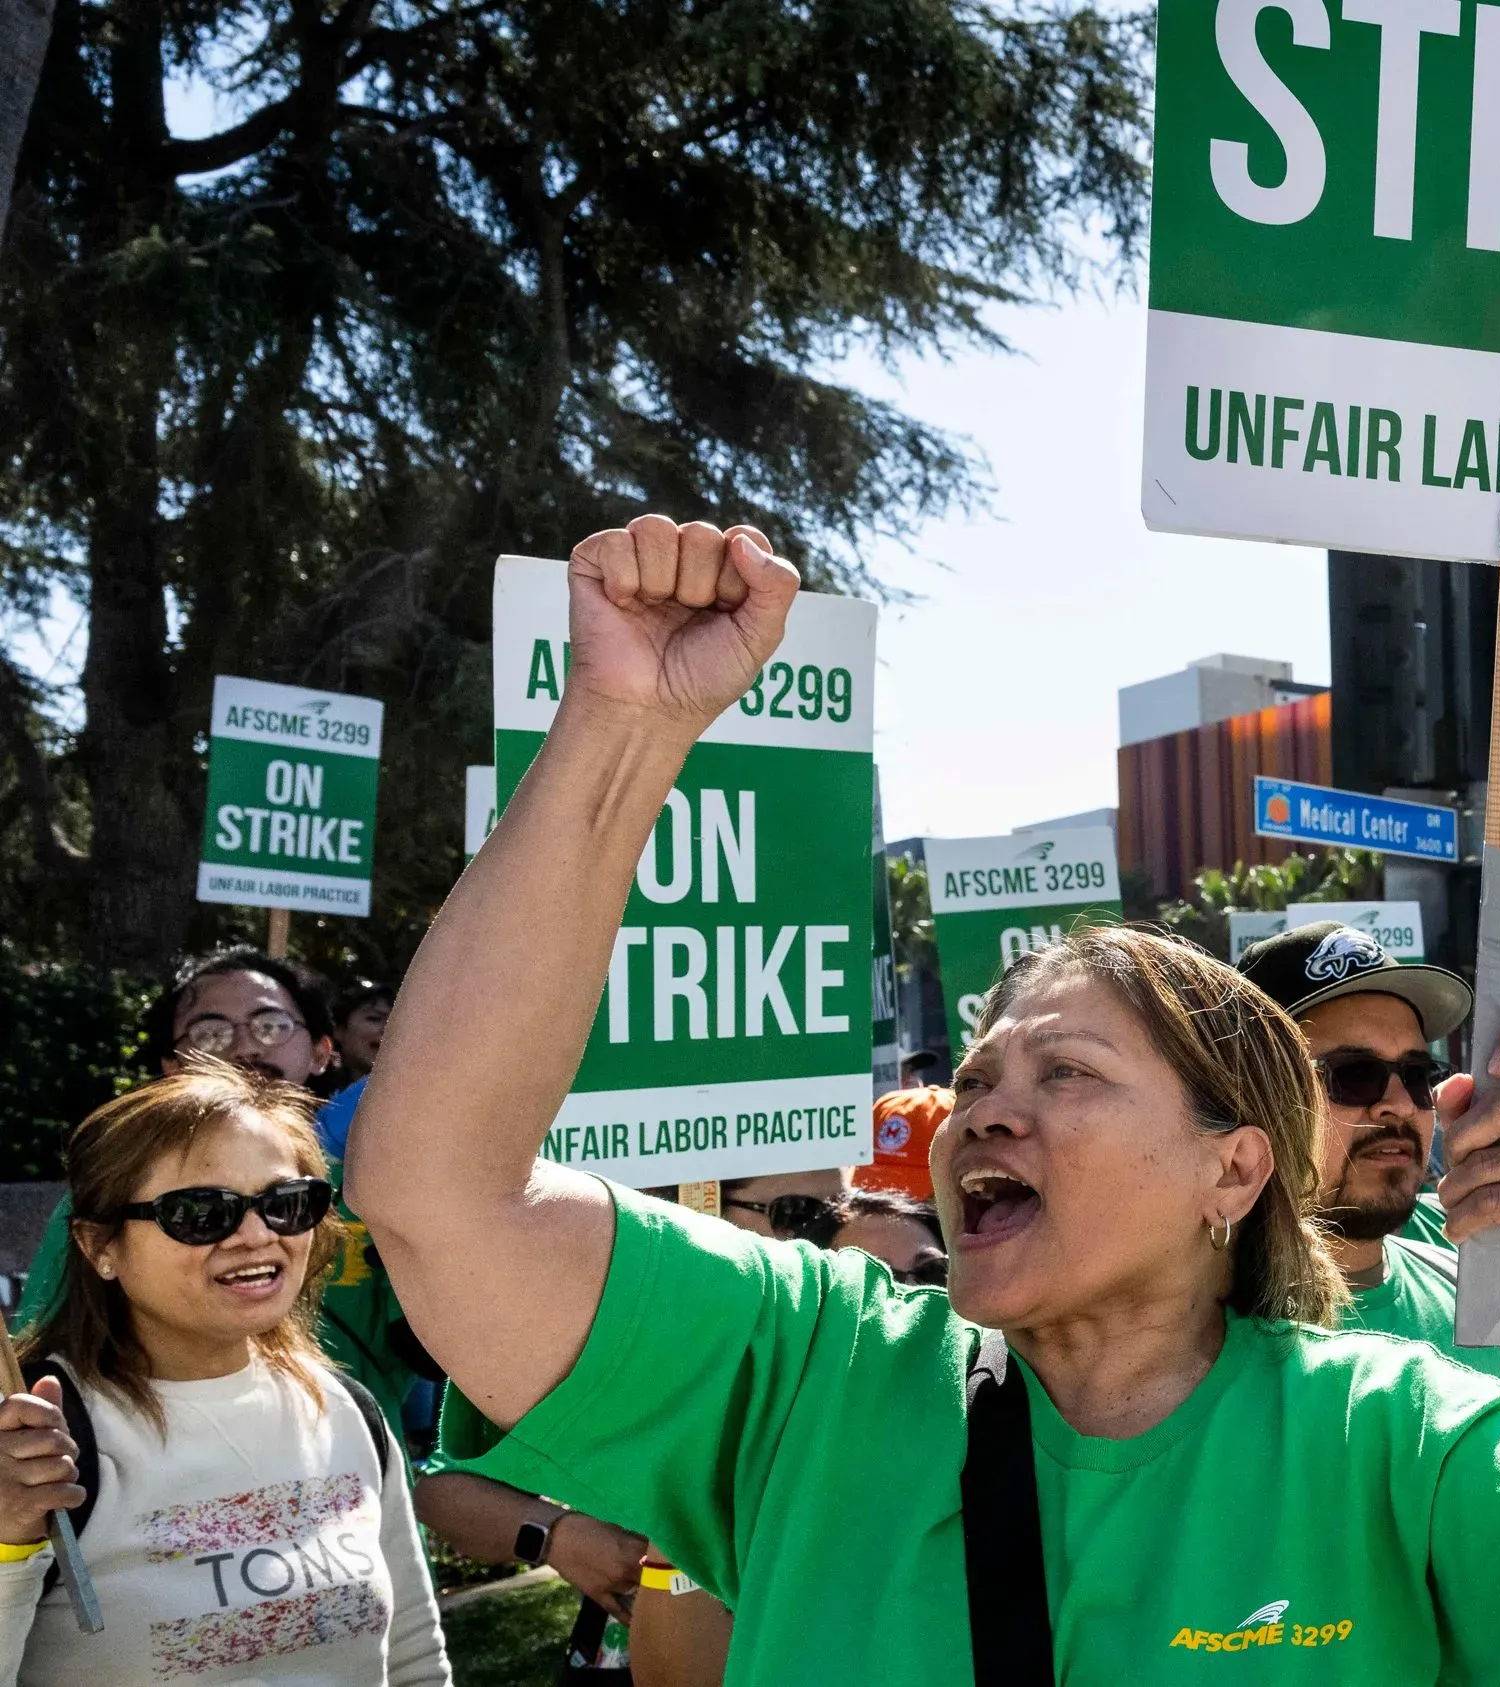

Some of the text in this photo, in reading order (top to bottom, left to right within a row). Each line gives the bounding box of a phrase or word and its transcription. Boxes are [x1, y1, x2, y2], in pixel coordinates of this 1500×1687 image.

[1185, 385, 1402, 483] UNFAIR
[738, 661, 853, 723] 3299
[225, 706, 371, 746] AFSCME 3299
[265, 759, 324, 809] ON
[215, 804, 364, 864] STRIKE
[636, 788, 756, 903] ON
[1300, 797, 1356, 836] Medical
[1361, 808, 1408, 844] Center
[209, 877, 361, 903] UNFAIR LABOR PRACTICE
[944, 861, 1106, 898] AFSCME 3299
[1374, 927, 1414, 948] 3299
[607, 925, 850, 1045] TRIKE
[543, 1123, 629, 1163] NFAIR
[638, 1115, 727, 1155] LABOR
[736, 1105, 856, 1147] PRACTICE
[194, 1533, 375, 1607] TOMS
[1169, 1619, 1353, 1652] AFSCME 3299
